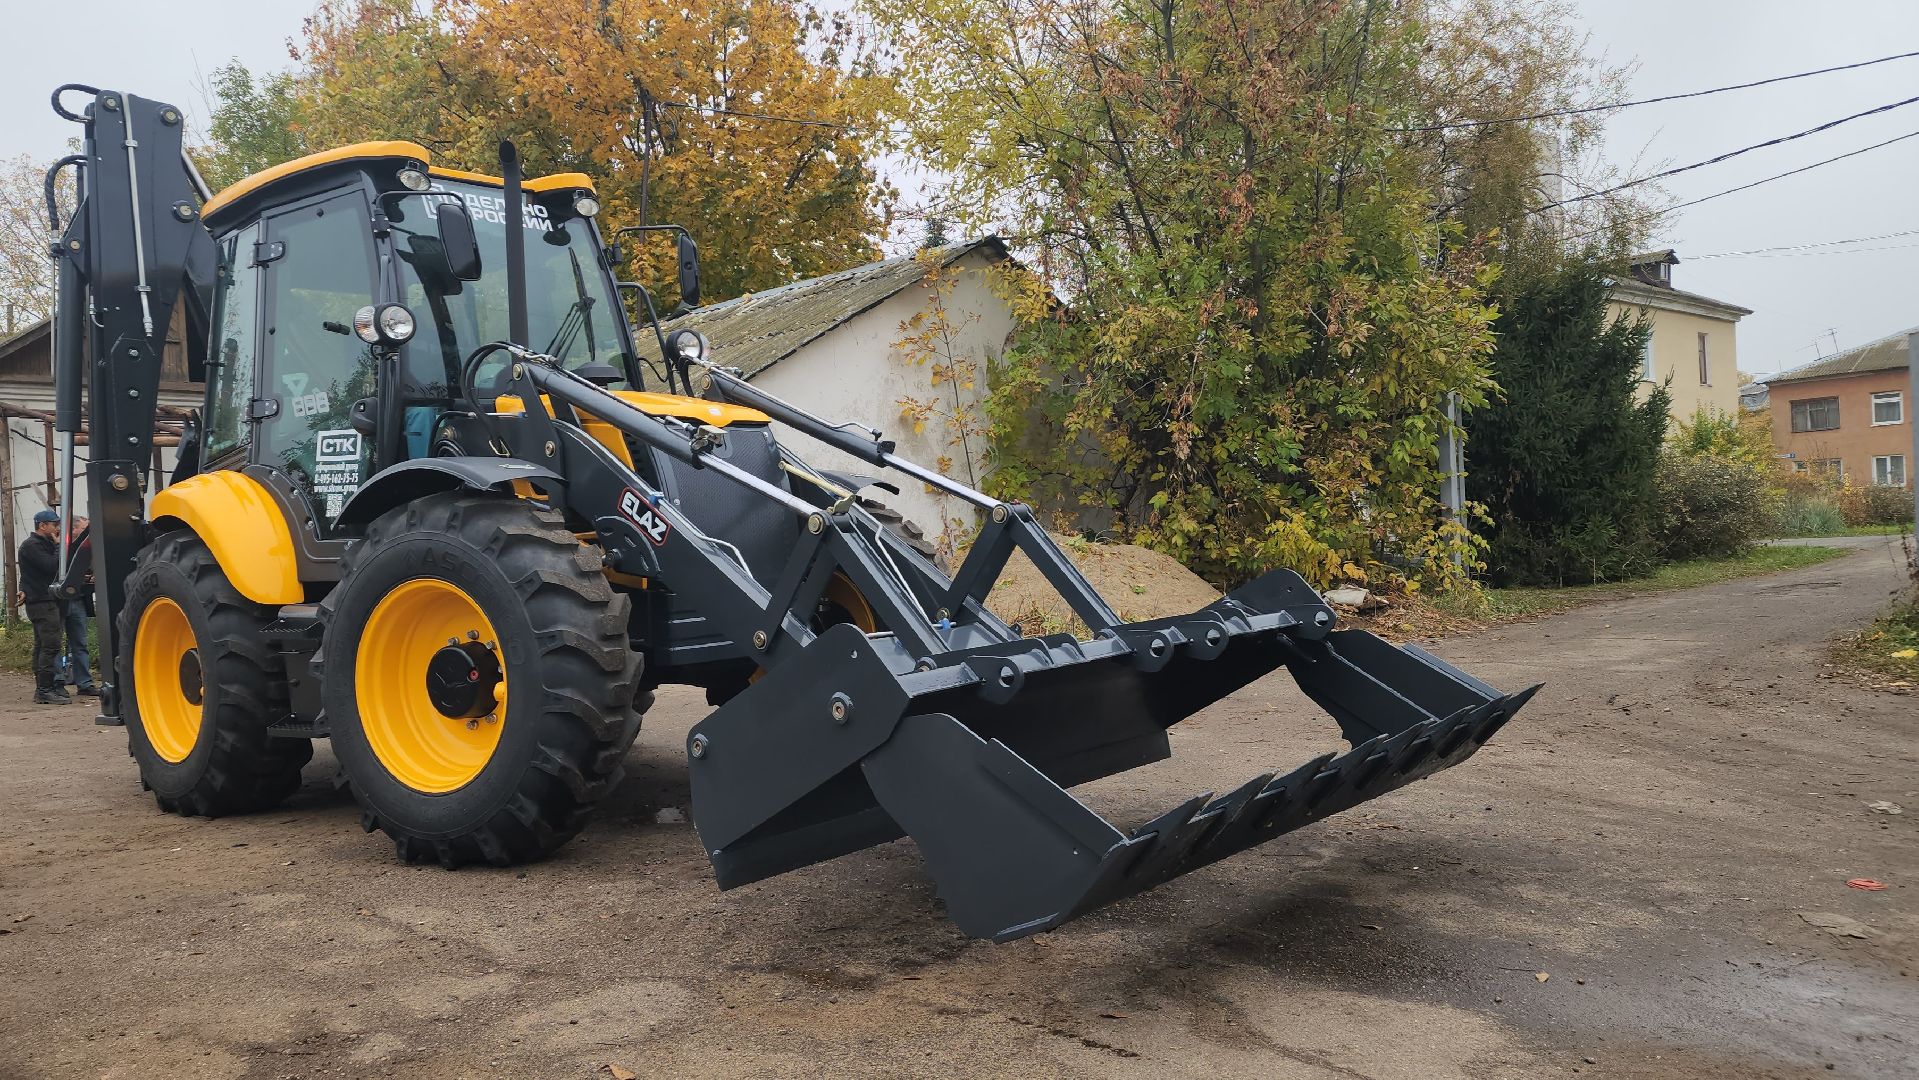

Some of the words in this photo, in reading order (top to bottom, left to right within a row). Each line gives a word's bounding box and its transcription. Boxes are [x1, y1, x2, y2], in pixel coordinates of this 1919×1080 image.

[450, 191, 548, 218] СДЕЛНО
[469, 207, 554, 232] РОСИИ
[621, 491, 668, 542] ELAZ
